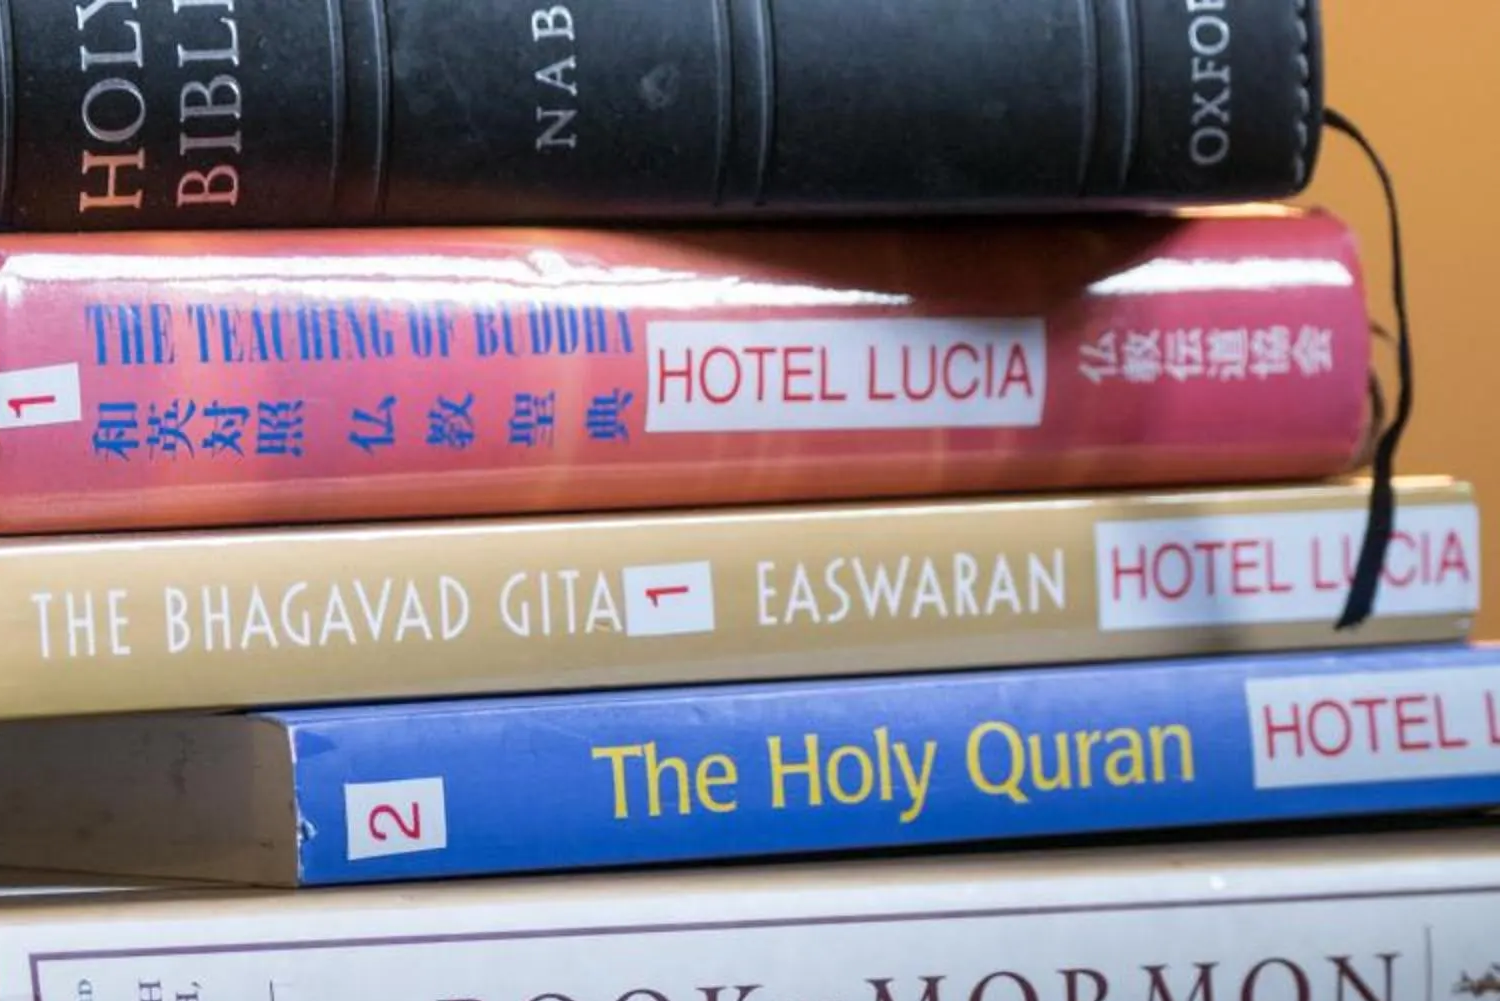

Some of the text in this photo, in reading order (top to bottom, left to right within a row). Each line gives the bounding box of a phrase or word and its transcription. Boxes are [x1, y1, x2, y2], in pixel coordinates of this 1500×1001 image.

[172, 0, 242, 207] BIBL
[531, 5, 578, 151] NAB
[1186, 0, 1231, 165] OXFO
[84, 300, 635, 366] THE TEACHING OF BUDDHA
[657, 341, 1034, 404] HOTEL LUCIA
[7, 395, 56, 419] 1
[645, 584, 690, 608] 1
[756, 549, 1067, 628] EASWARAN
[1111, 536, 1293, 601] HOTEL
[31, 570, 625, 659] THE BHAGAVAD GITA
[1263, 693, 1469, 761] HOTEL
[592, 720, 1195, 823] The Holy Quran
[369, 803, 420, 841] 2
